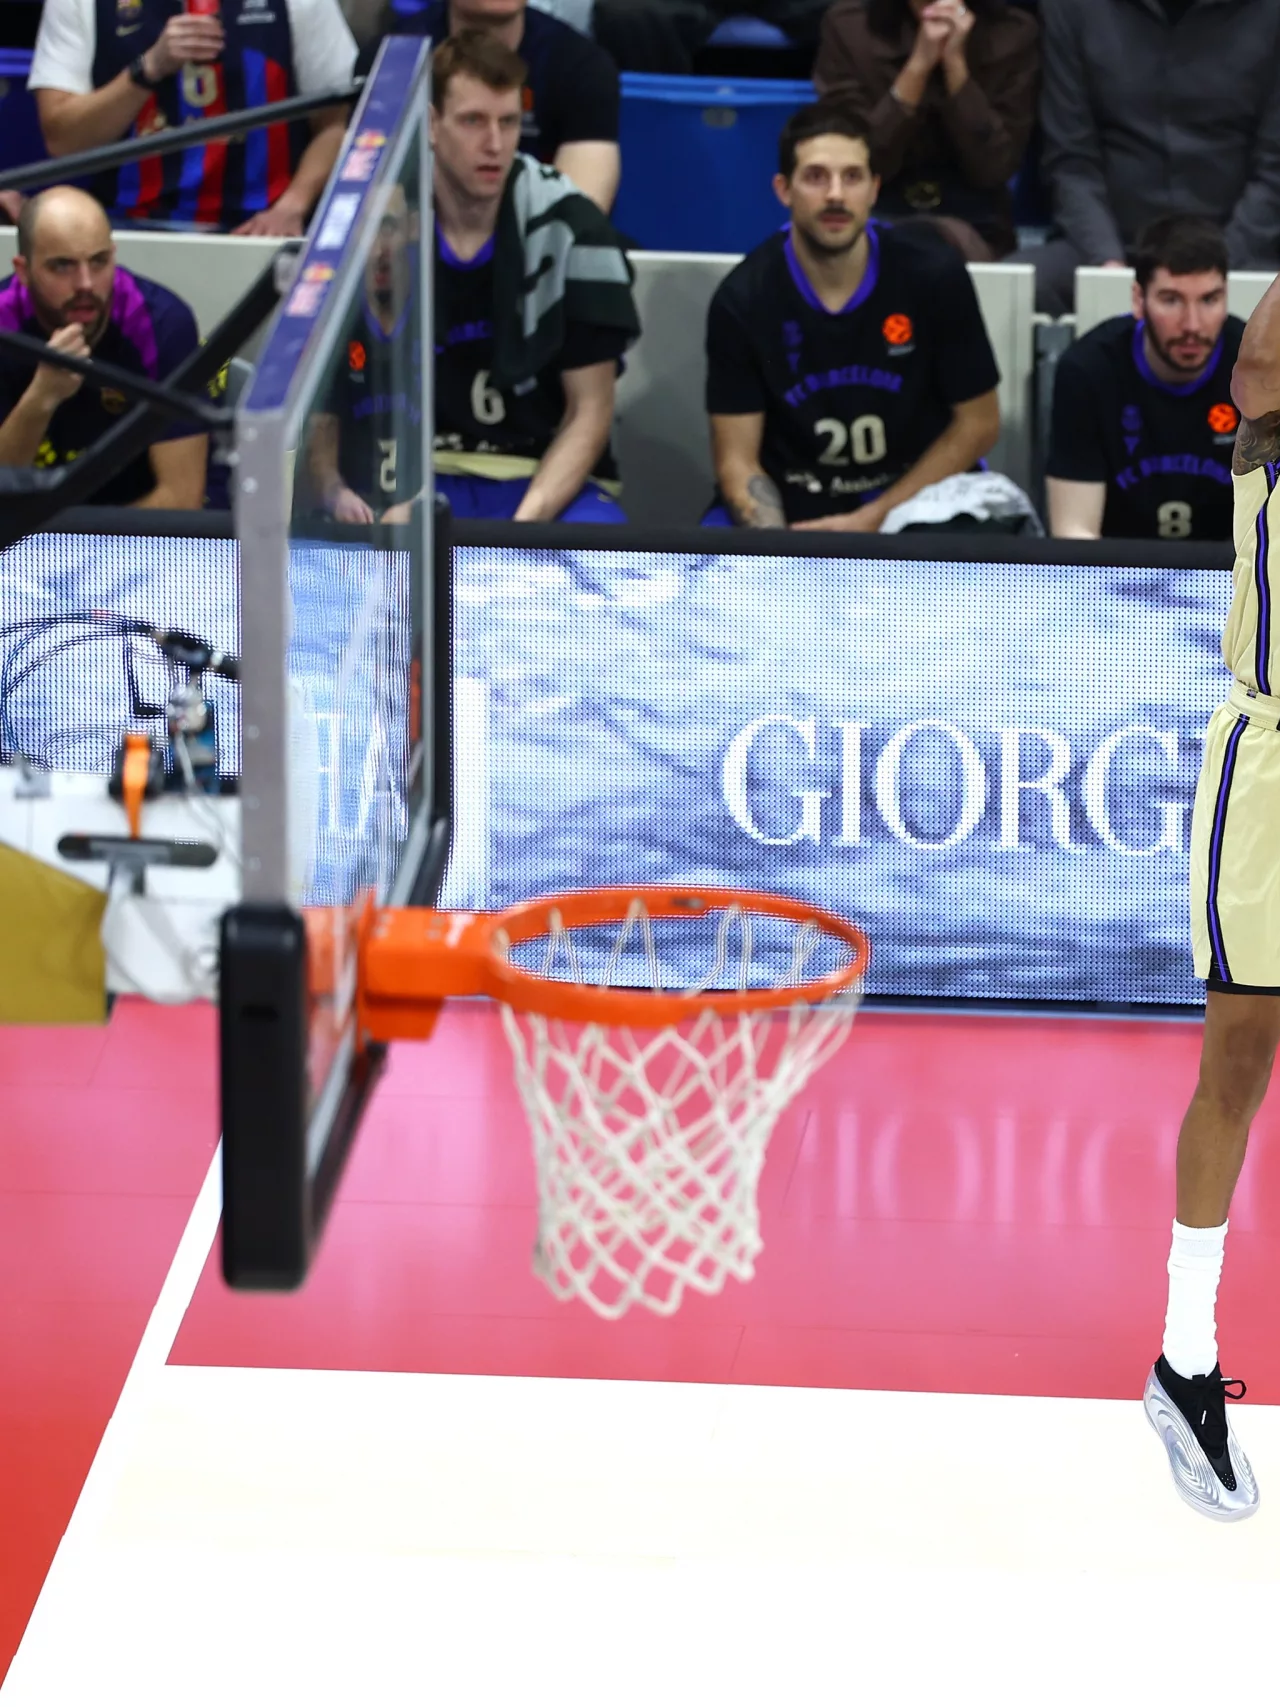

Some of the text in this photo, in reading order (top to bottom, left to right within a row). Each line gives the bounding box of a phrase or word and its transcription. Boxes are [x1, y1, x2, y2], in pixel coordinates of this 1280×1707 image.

[471, 369, 506, 425] 6
[814, 414, 887, 467] 20
[1157, 500, 1192, 538] 8
[722, 713, 1203, 855] GIORG
